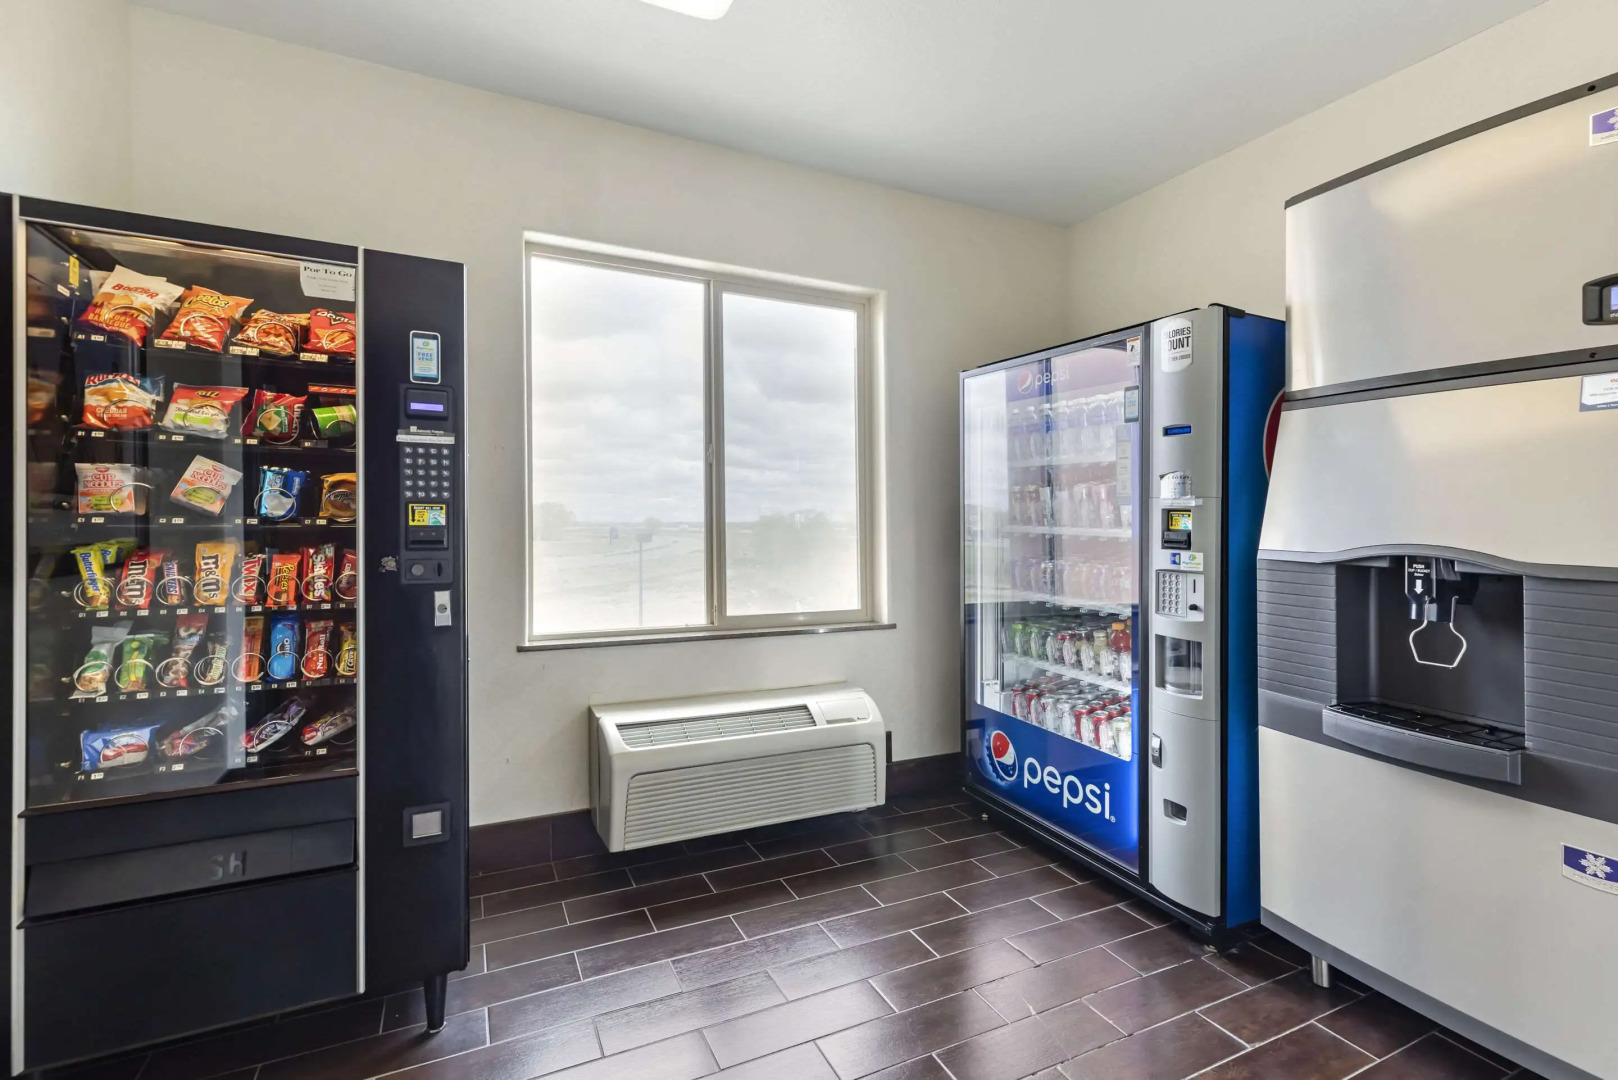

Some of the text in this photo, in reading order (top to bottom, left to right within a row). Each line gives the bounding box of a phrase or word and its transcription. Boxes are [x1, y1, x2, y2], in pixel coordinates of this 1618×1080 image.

[338, 269, 353, 278] Go
[1034, 364, 1070, 390] pepsi
[83, 479, 124, 489] NOODLES
[90, 473, 116, 482] CUP
[190, 470, 228, 491] NOODLES
[202, 469, 224, 482] CUP
[242, 556, 263, 594] TWIX
[1024, 757, 1110, 820] pepsi
